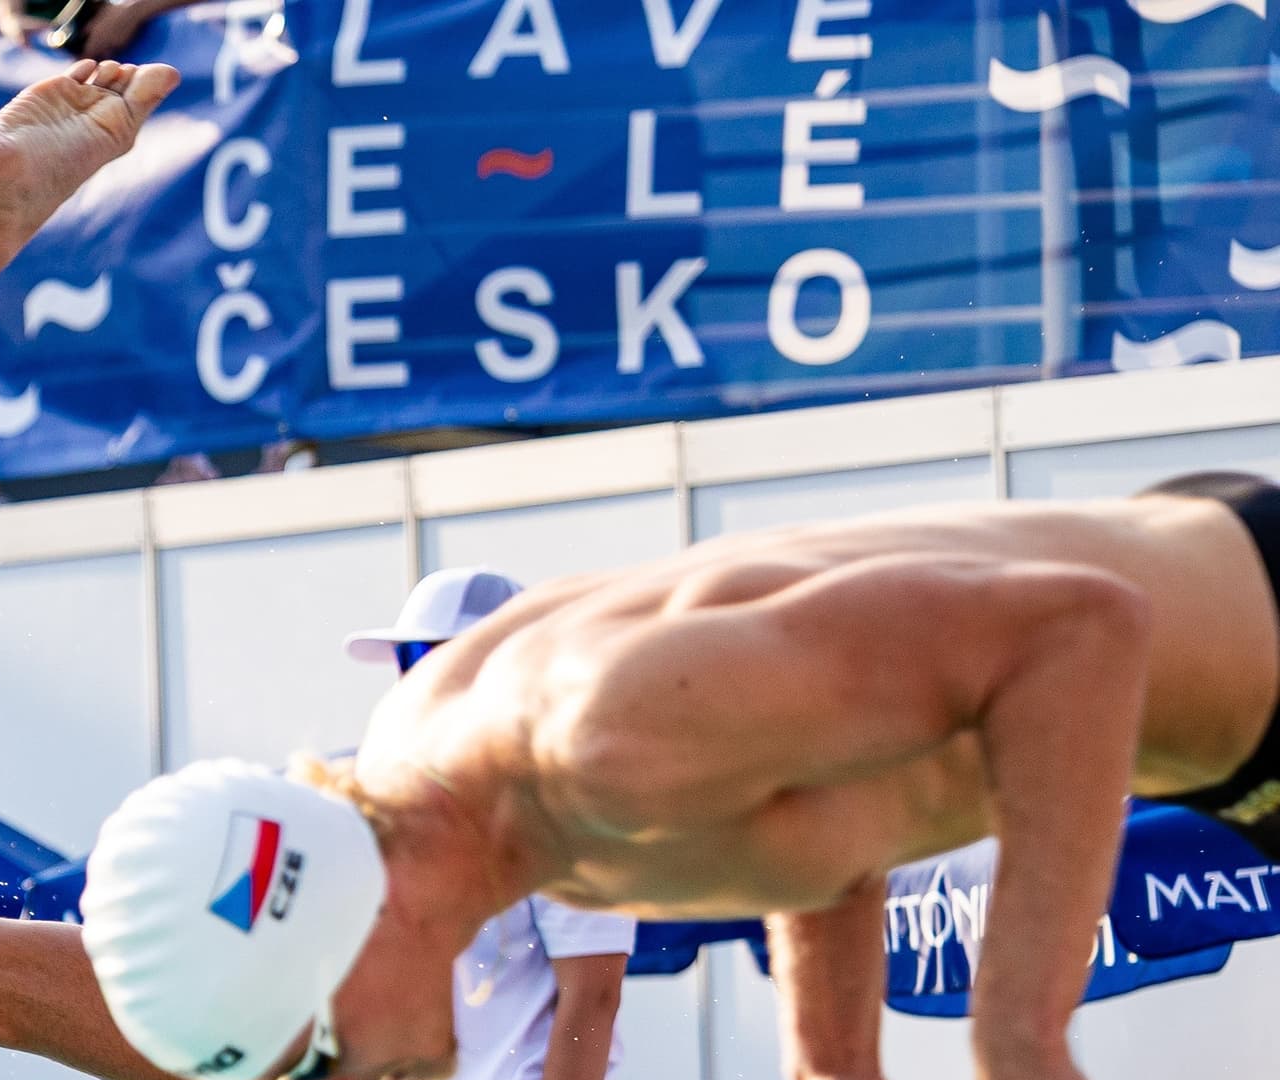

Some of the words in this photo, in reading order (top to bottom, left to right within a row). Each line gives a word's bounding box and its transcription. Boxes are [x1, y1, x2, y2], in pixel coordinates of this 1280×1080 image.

[196, 248, 873, 404] ČESKO
[269, 849, 305, 922] CZE
[1144, 865, 1280, 921] MAT
